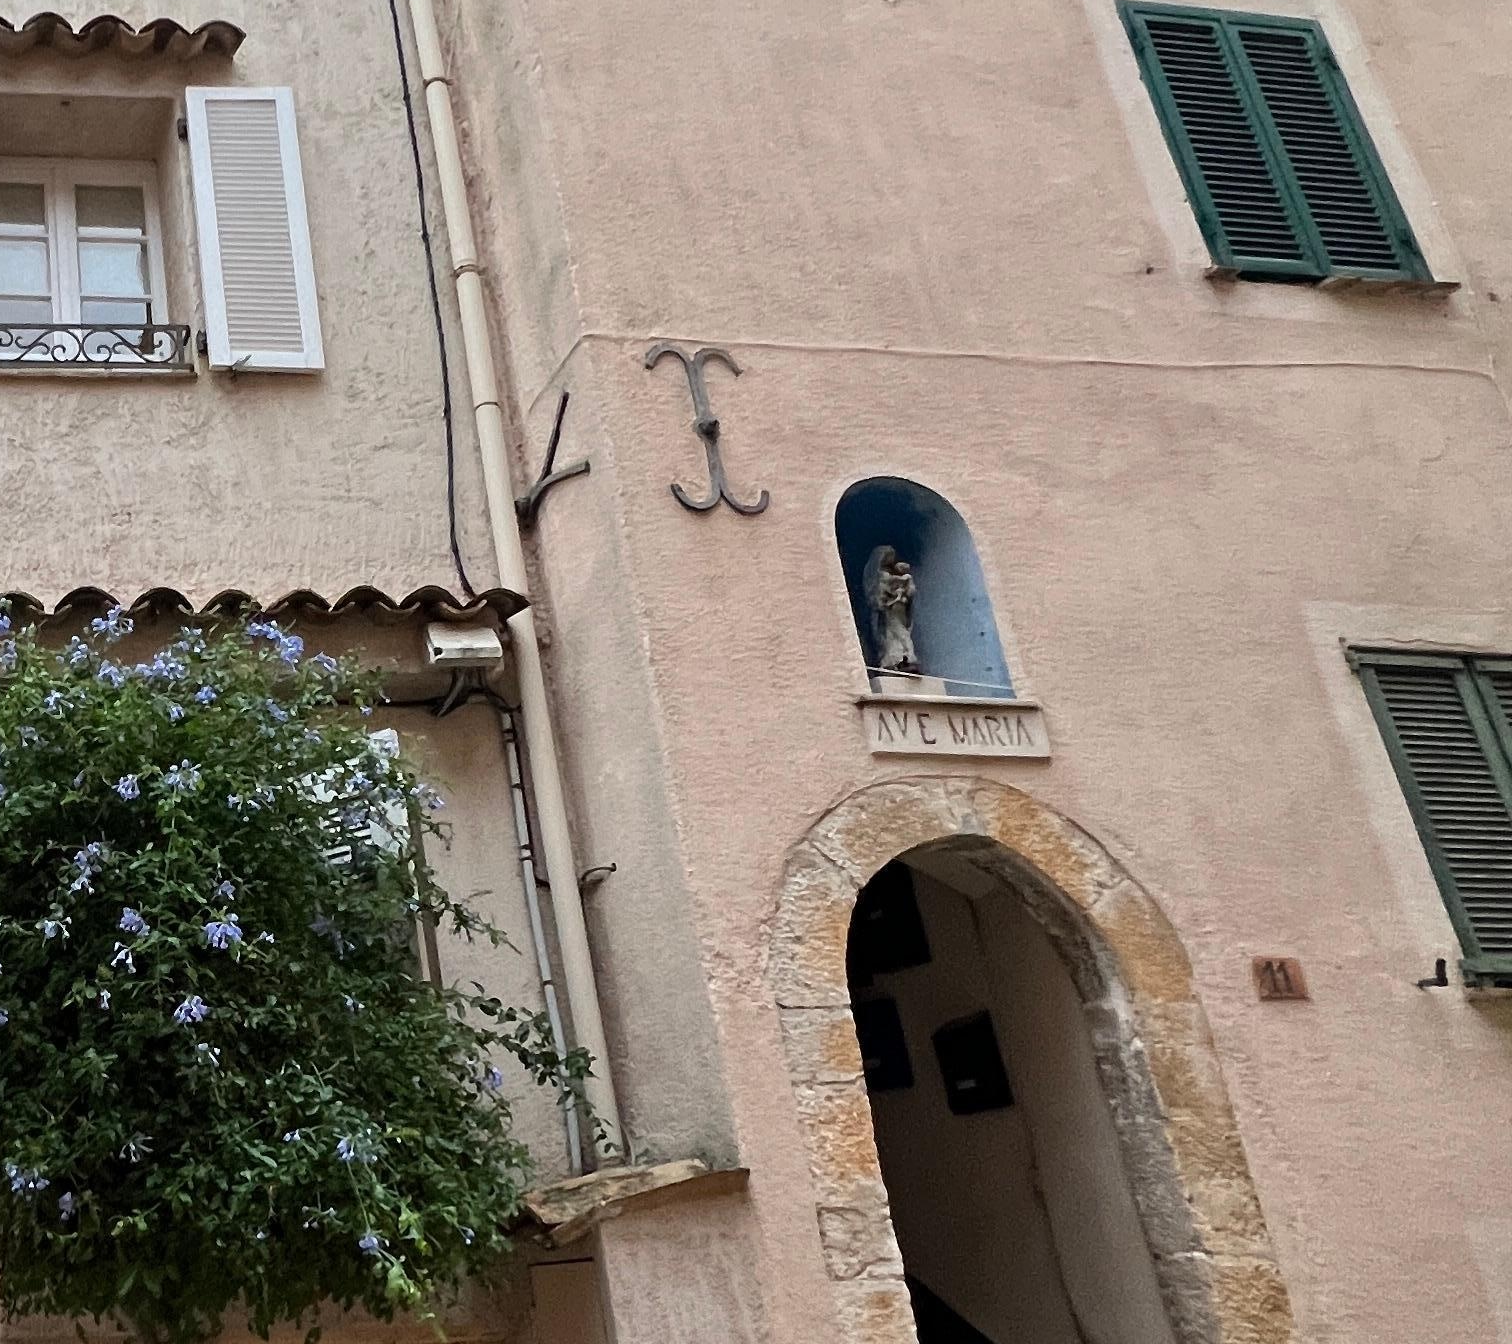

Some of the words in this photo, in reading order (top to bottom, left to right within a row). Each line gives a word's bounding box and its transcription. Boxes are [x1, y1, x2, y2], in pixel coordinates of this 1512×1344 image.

[877, 711, 937, 745] AVE
[946, 713, 1035, 747] MARIA
[1262, 960, 1295, 994] 11
